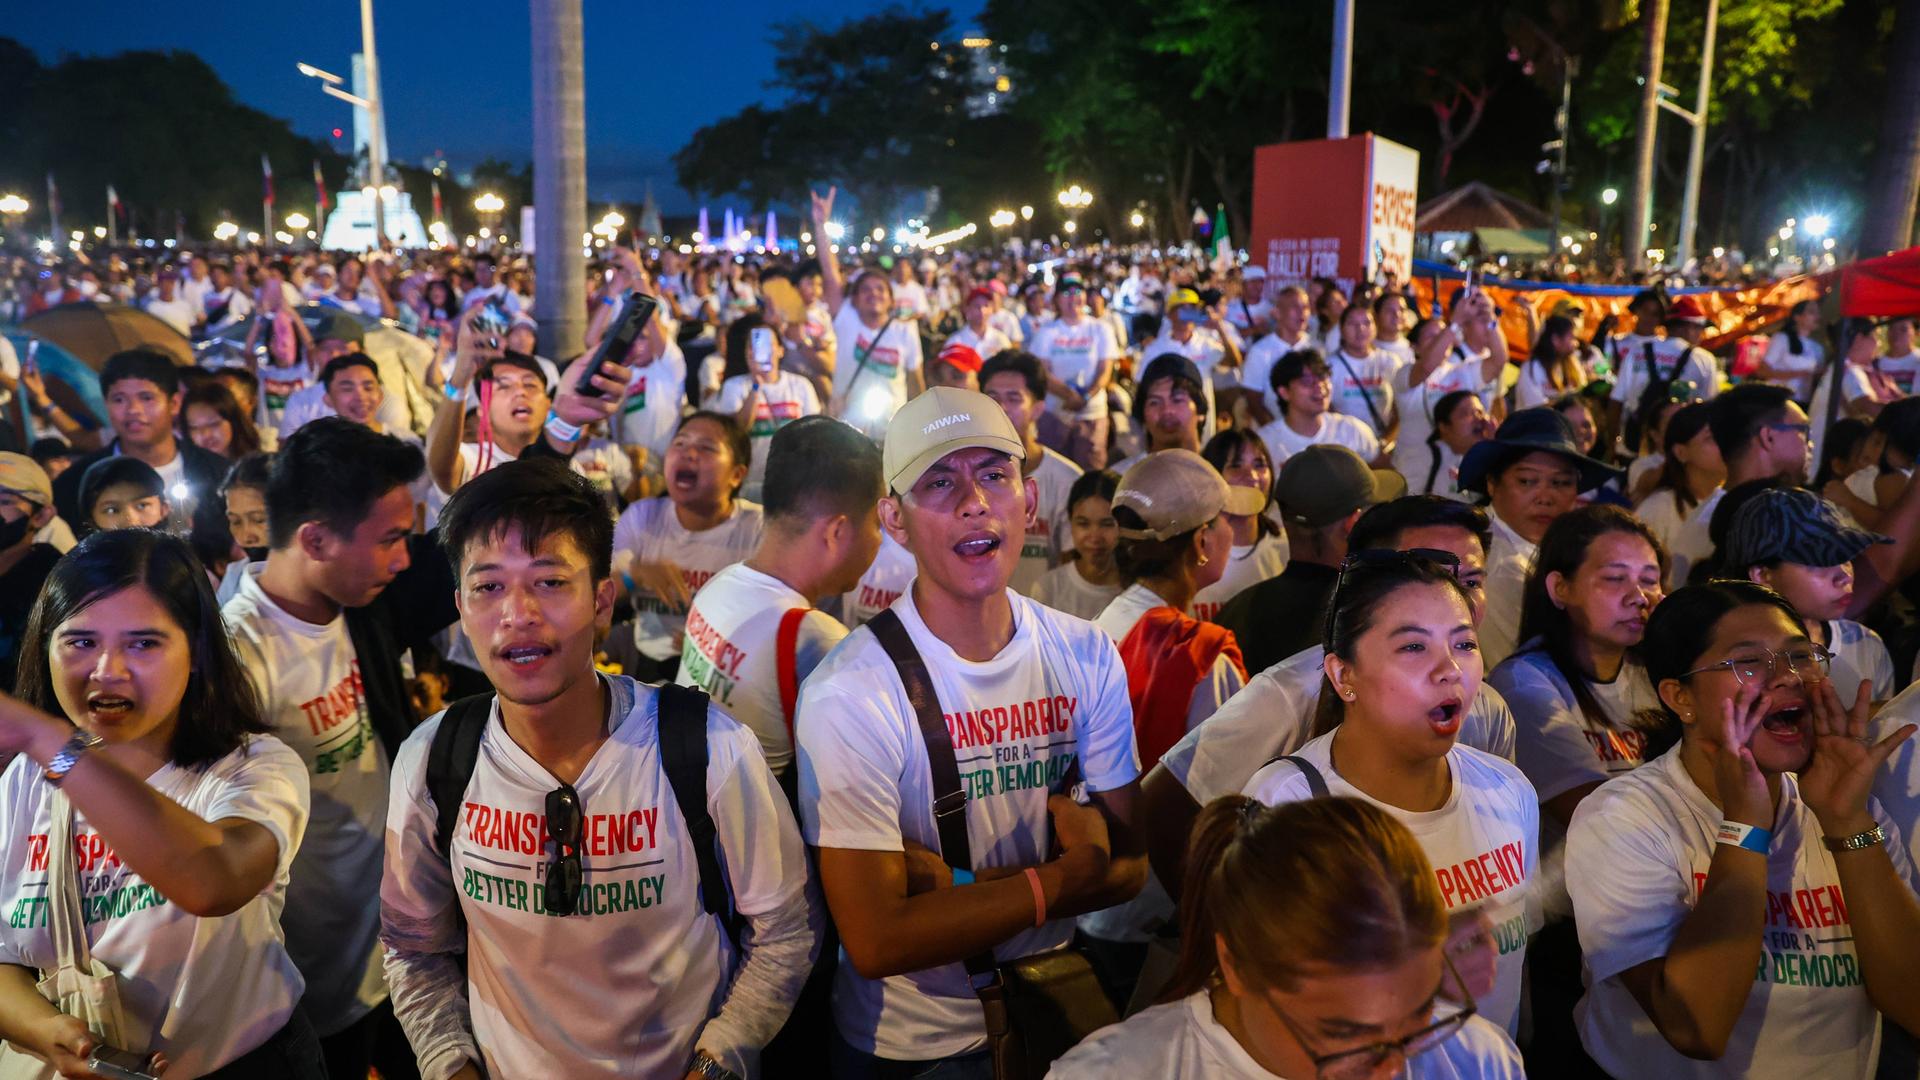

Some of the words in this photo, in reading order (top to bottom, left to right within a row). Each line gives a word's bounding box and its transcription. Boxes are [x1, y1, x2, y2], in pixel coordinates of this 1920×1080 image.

[1268, 251, 1309, 277] RALLY
[1311, 250, 1339, 277] FOR
[922, 413, 971, 435] TAIWAN
[996, 745, 1020, 763] FOR
[1023, 743, 1031, 759] A
[1435, 840, 1525, 908] PARENCY
[463, 866, 528, 912] BETTER
[533, 874, 665, 917] DOCRACY
[1771, 931, 1801, 950] FOR
[1805, 933, 1815, 950] A
